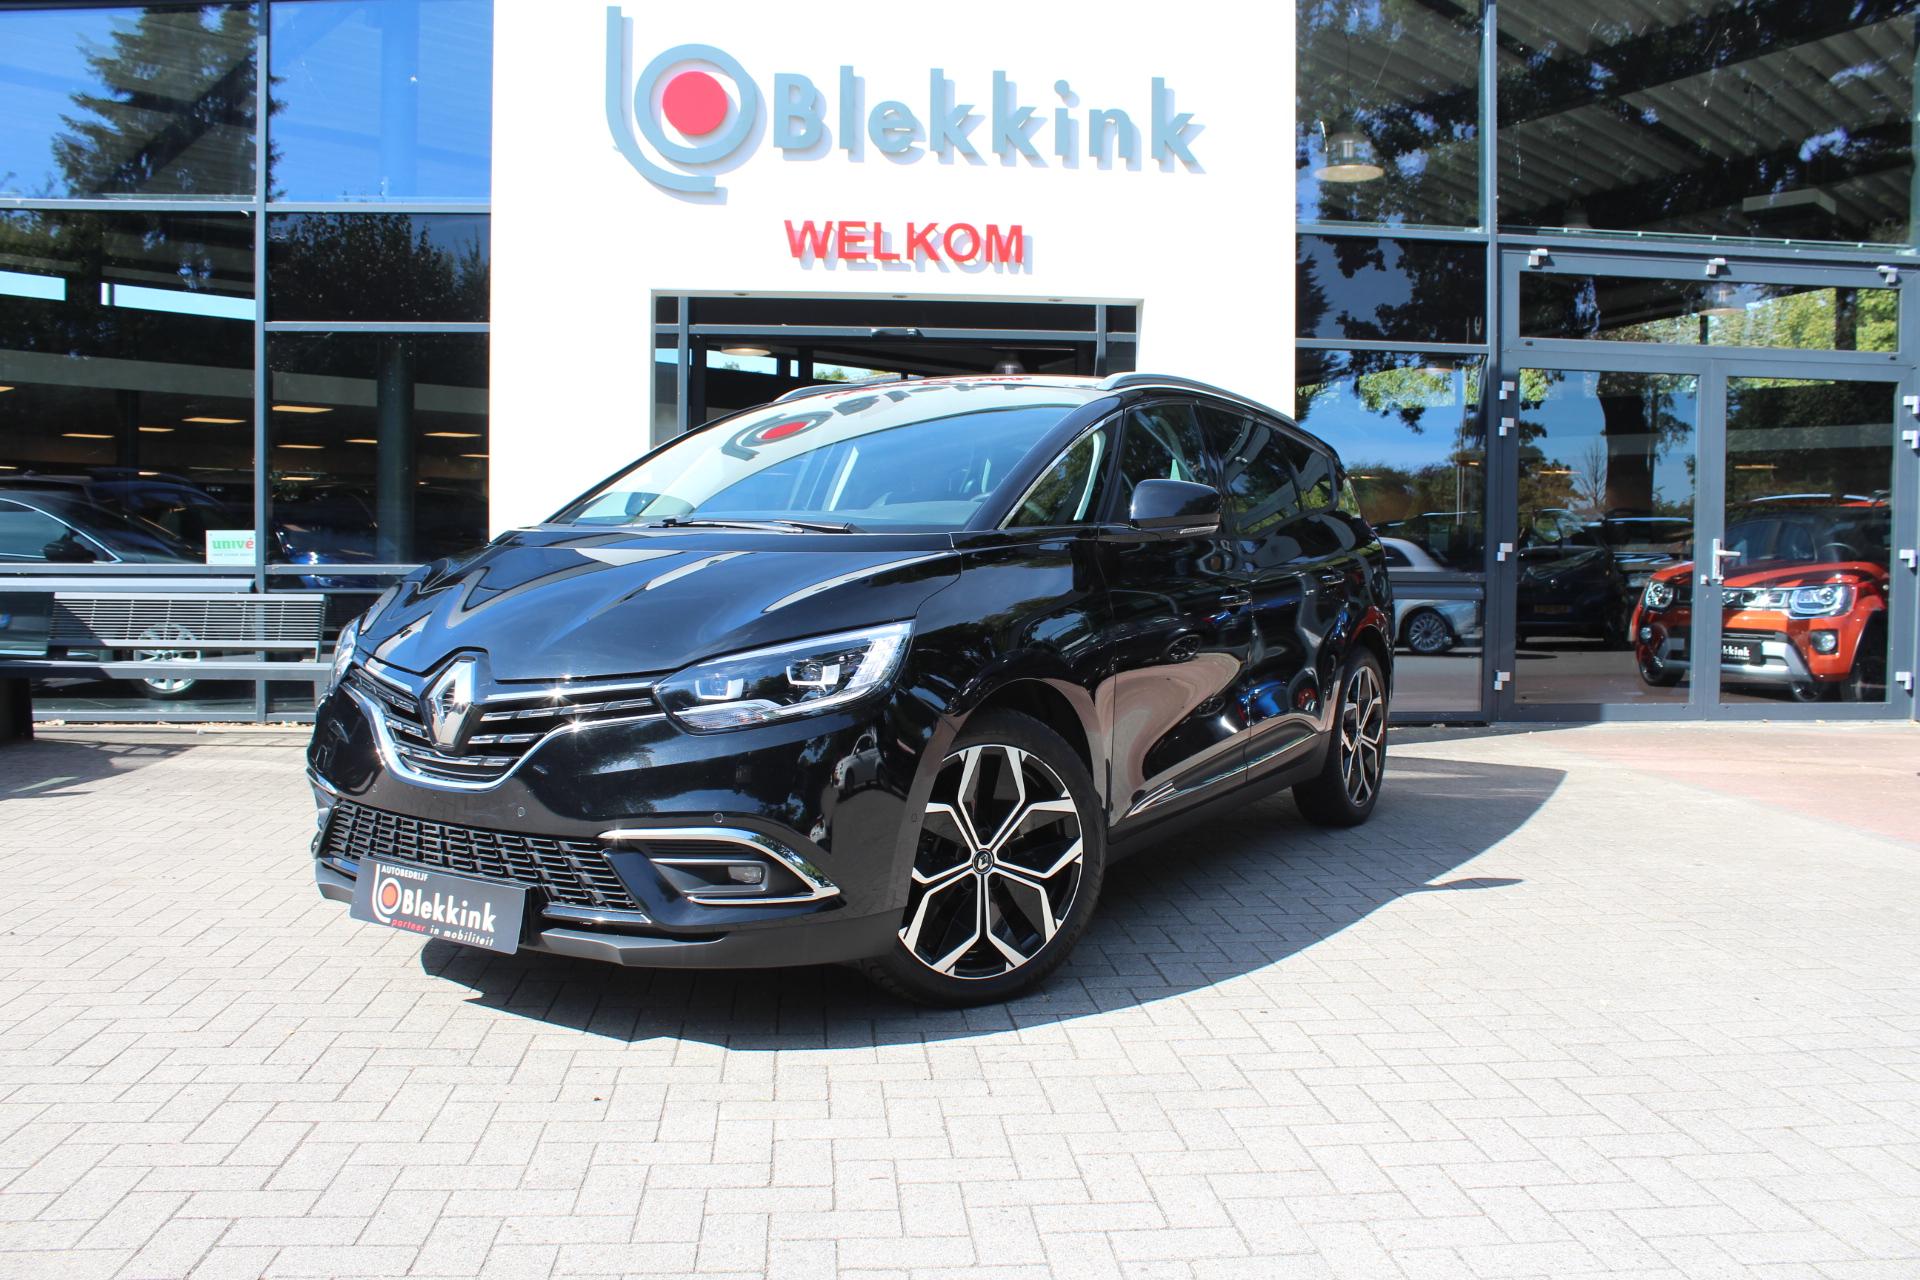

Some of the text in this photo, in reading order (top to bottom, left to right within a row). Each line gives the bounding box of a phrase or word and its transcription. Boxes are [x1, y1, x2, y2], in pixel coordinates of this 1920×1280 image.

[773, 65, 1199, 168] Blekkink
[784, 219, 1024, 264] WELKOM
[1722, 645, 1750, 656] kkink
[381, 864, 429, 882] AUTOBEDRIJF
[401, 887, 497, 933] Blekkink
[391, 918, 494, 947] partner in mobiliteit
